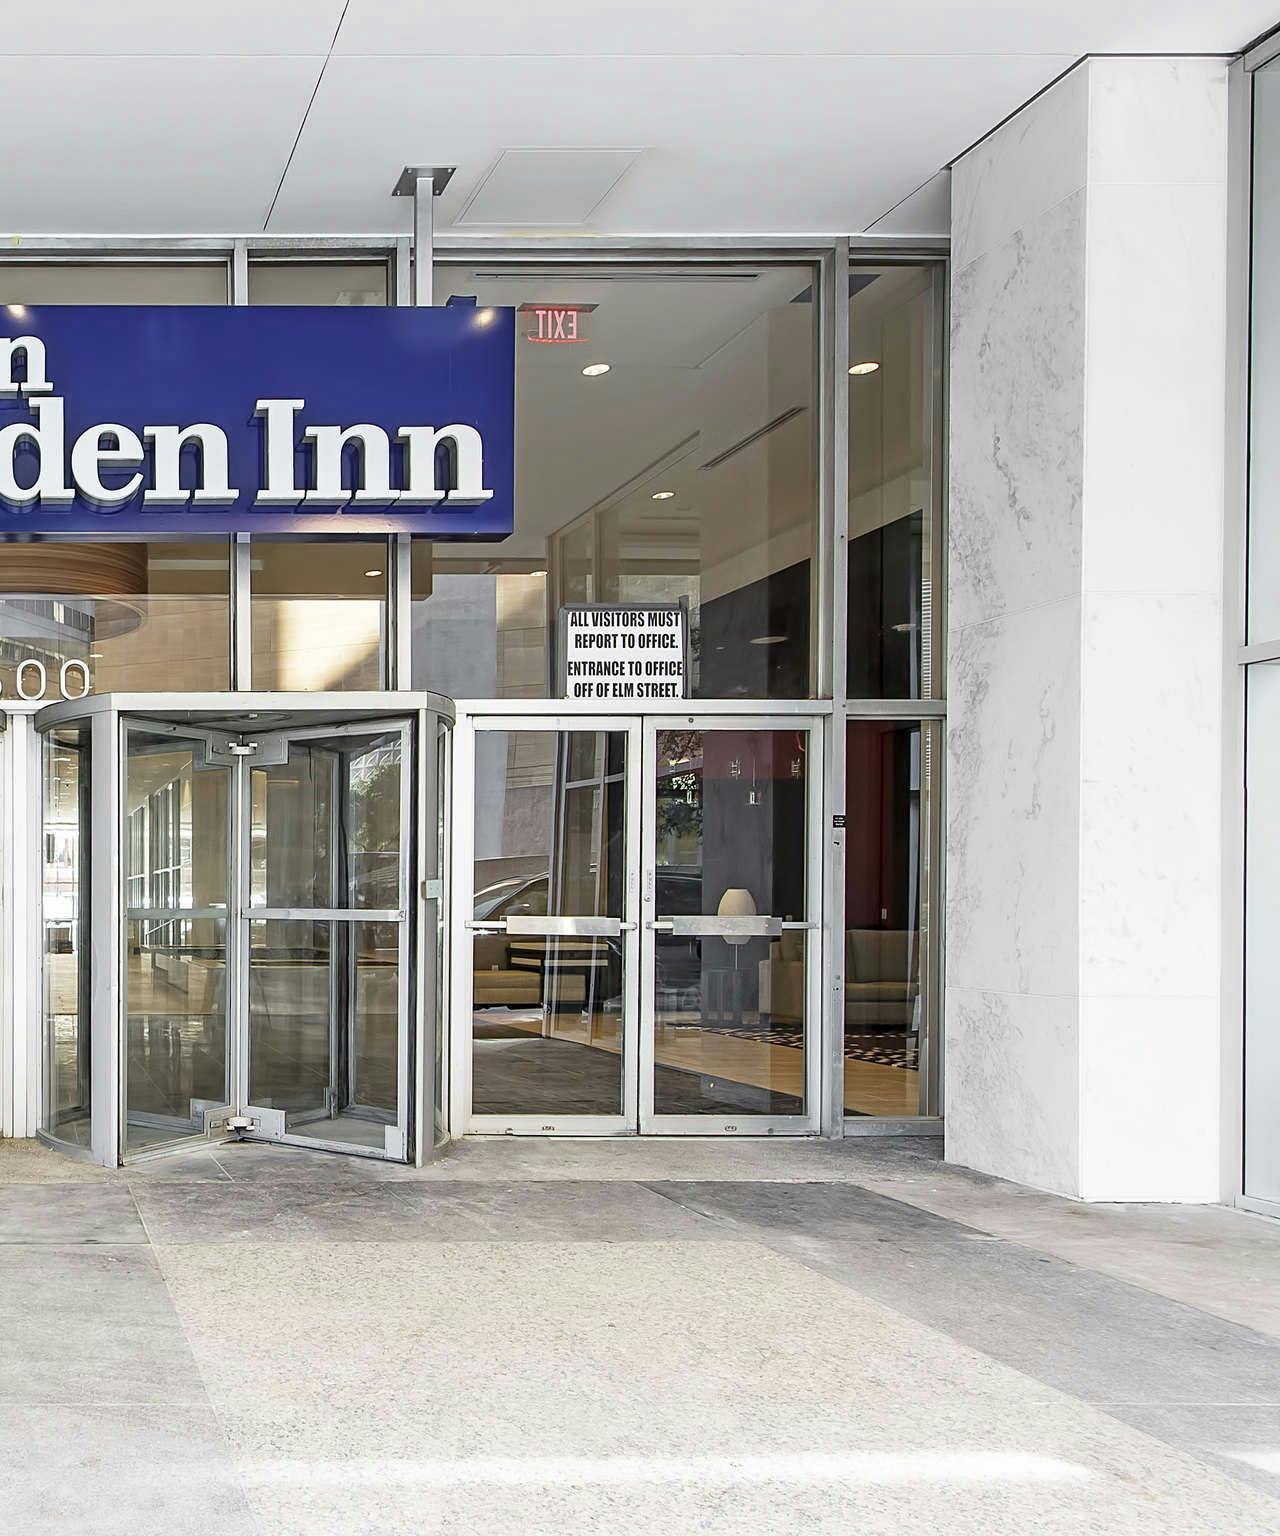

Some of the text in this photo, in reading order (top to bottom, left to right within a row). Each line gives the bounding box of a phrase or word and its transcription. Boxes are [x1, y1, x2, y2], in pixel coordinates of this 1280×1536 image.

[253, 398, 494, 506] Inn
[570, 611, 680, 627] ALL VISITORS MUST
[574, 633, 679, 649] REPORT TO OFFICE.
[567, 661, 683, 676] ENTRANCE TO OFFICE
[574, 682, 679, 698] OFF OF ELM STREET.
